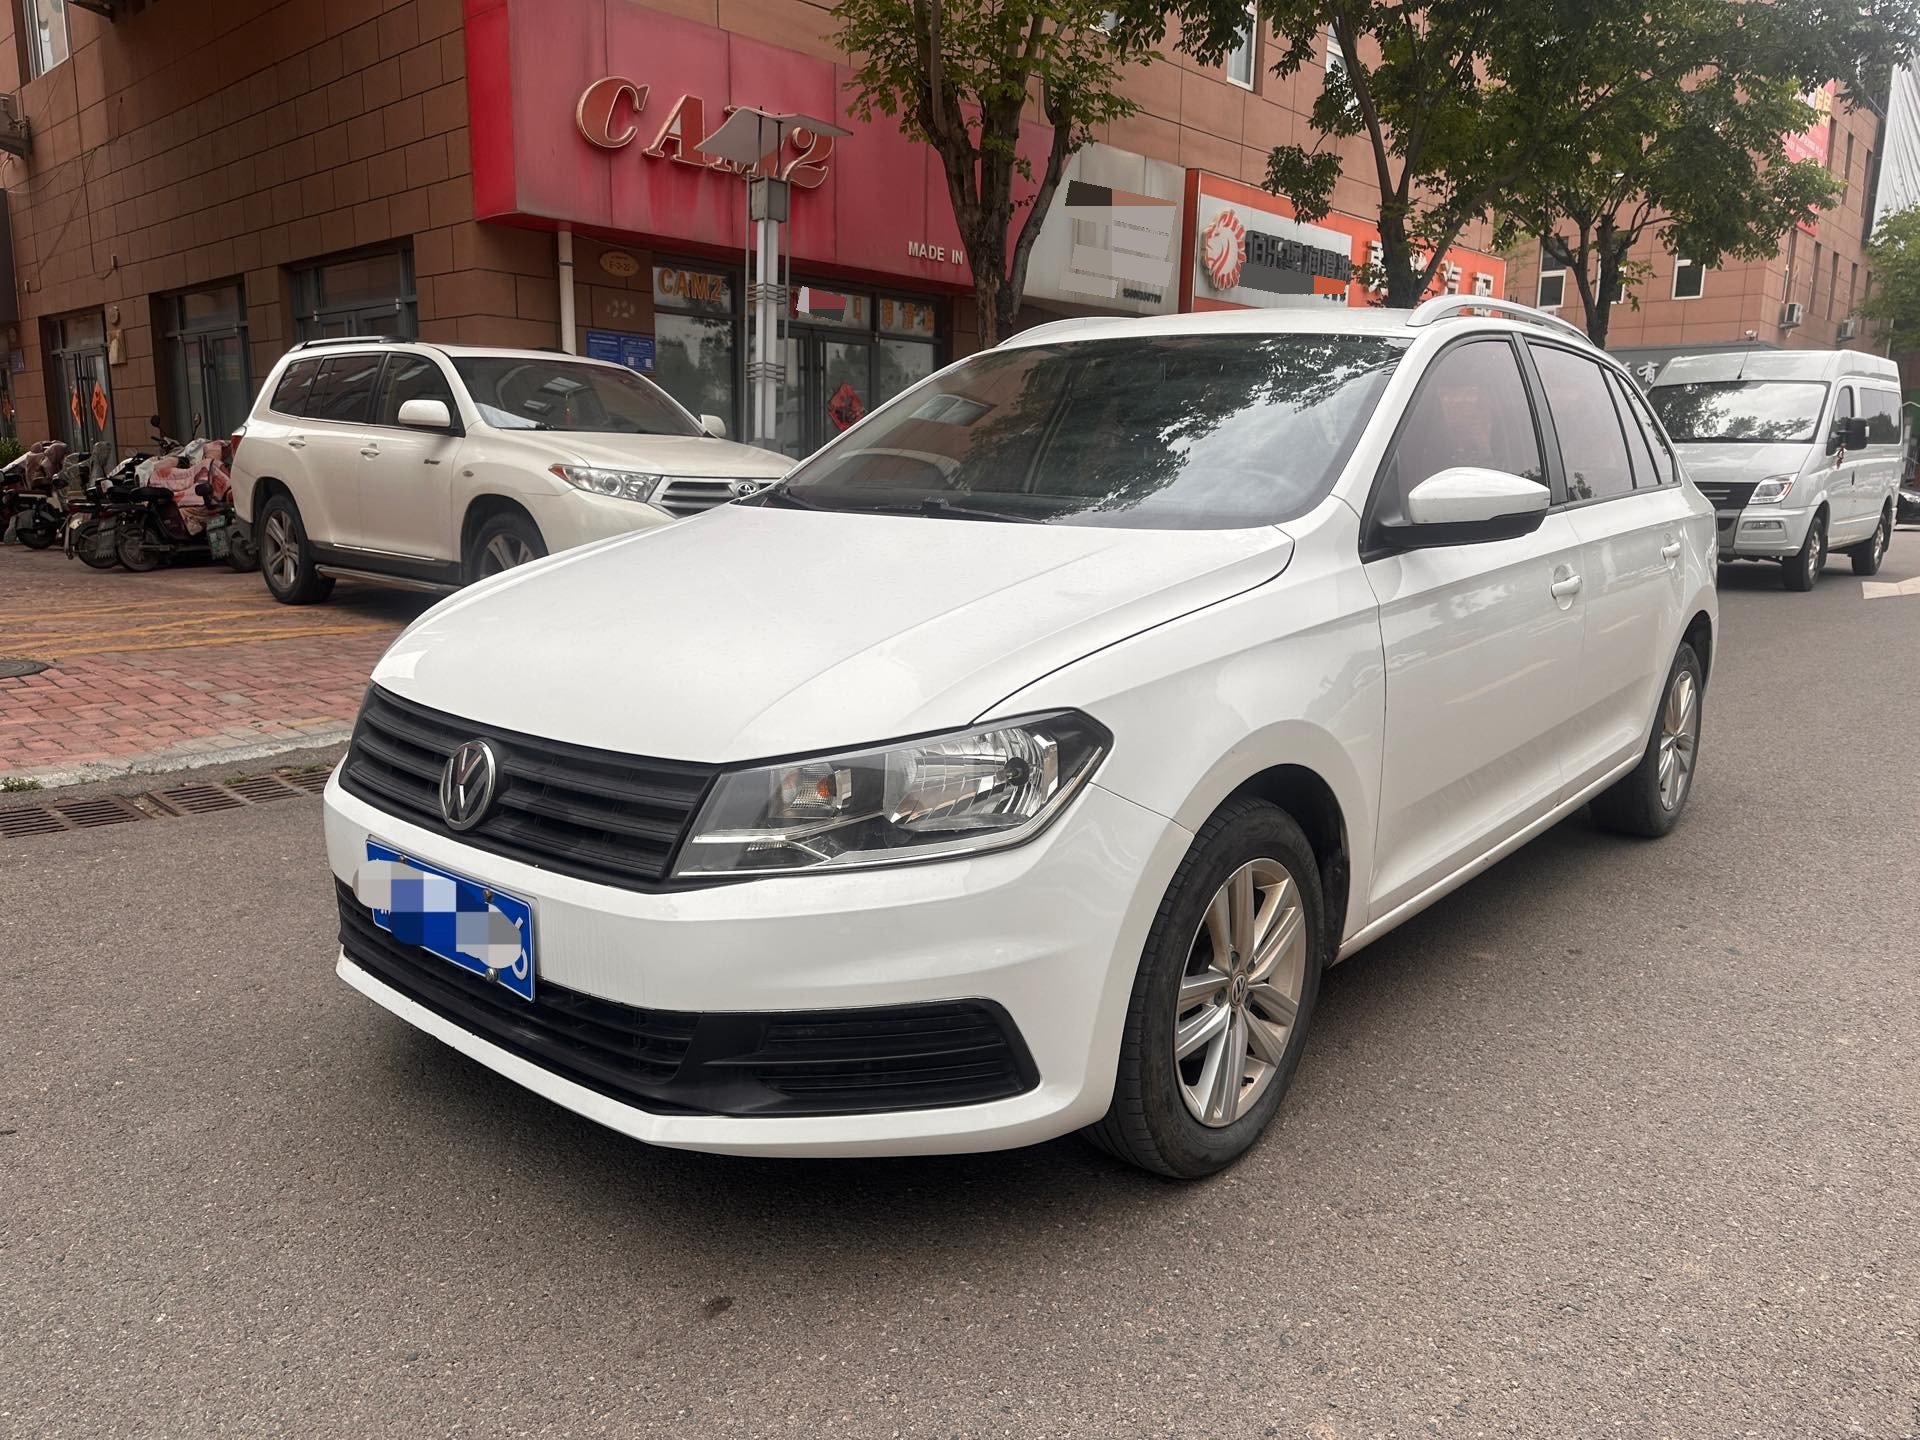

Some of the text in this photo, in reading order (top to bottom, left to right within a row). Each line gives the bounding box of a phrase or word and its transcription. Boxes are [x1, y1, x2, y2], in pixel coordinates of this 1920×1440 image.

[908, 240, 963, 265] MADE IN
[658, 267, 722, 303] CAM2
